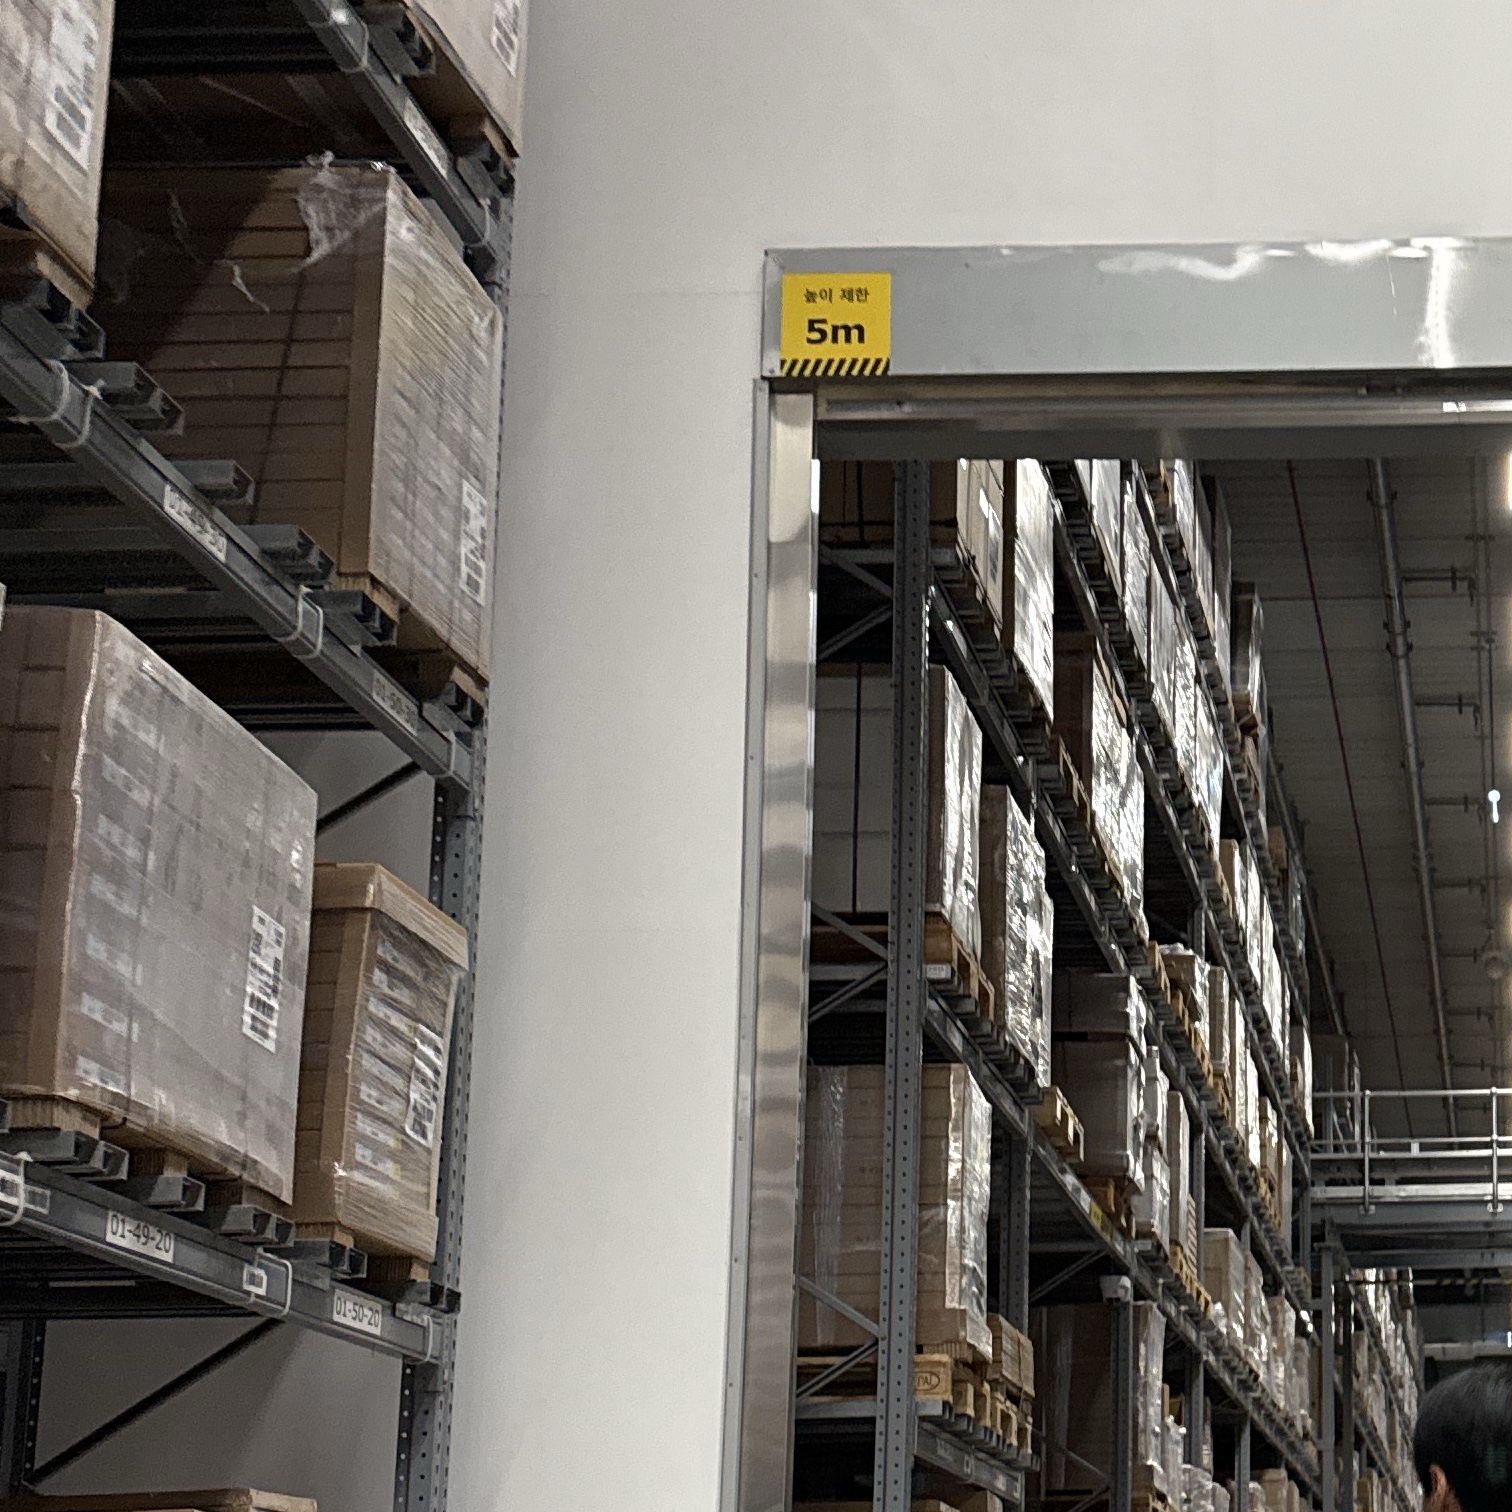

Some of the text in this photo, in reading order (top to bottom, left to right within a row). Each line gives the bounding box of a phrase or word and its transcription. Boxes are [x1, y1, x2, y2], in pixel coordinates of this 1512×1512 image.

[803, 286, 869, 304] 높이 제한
[805, 318, 866, 345] 5m
[110, 1213, 173, 1254] 01-49-20
[335, 1296, 380, 1328] 01-50-20
